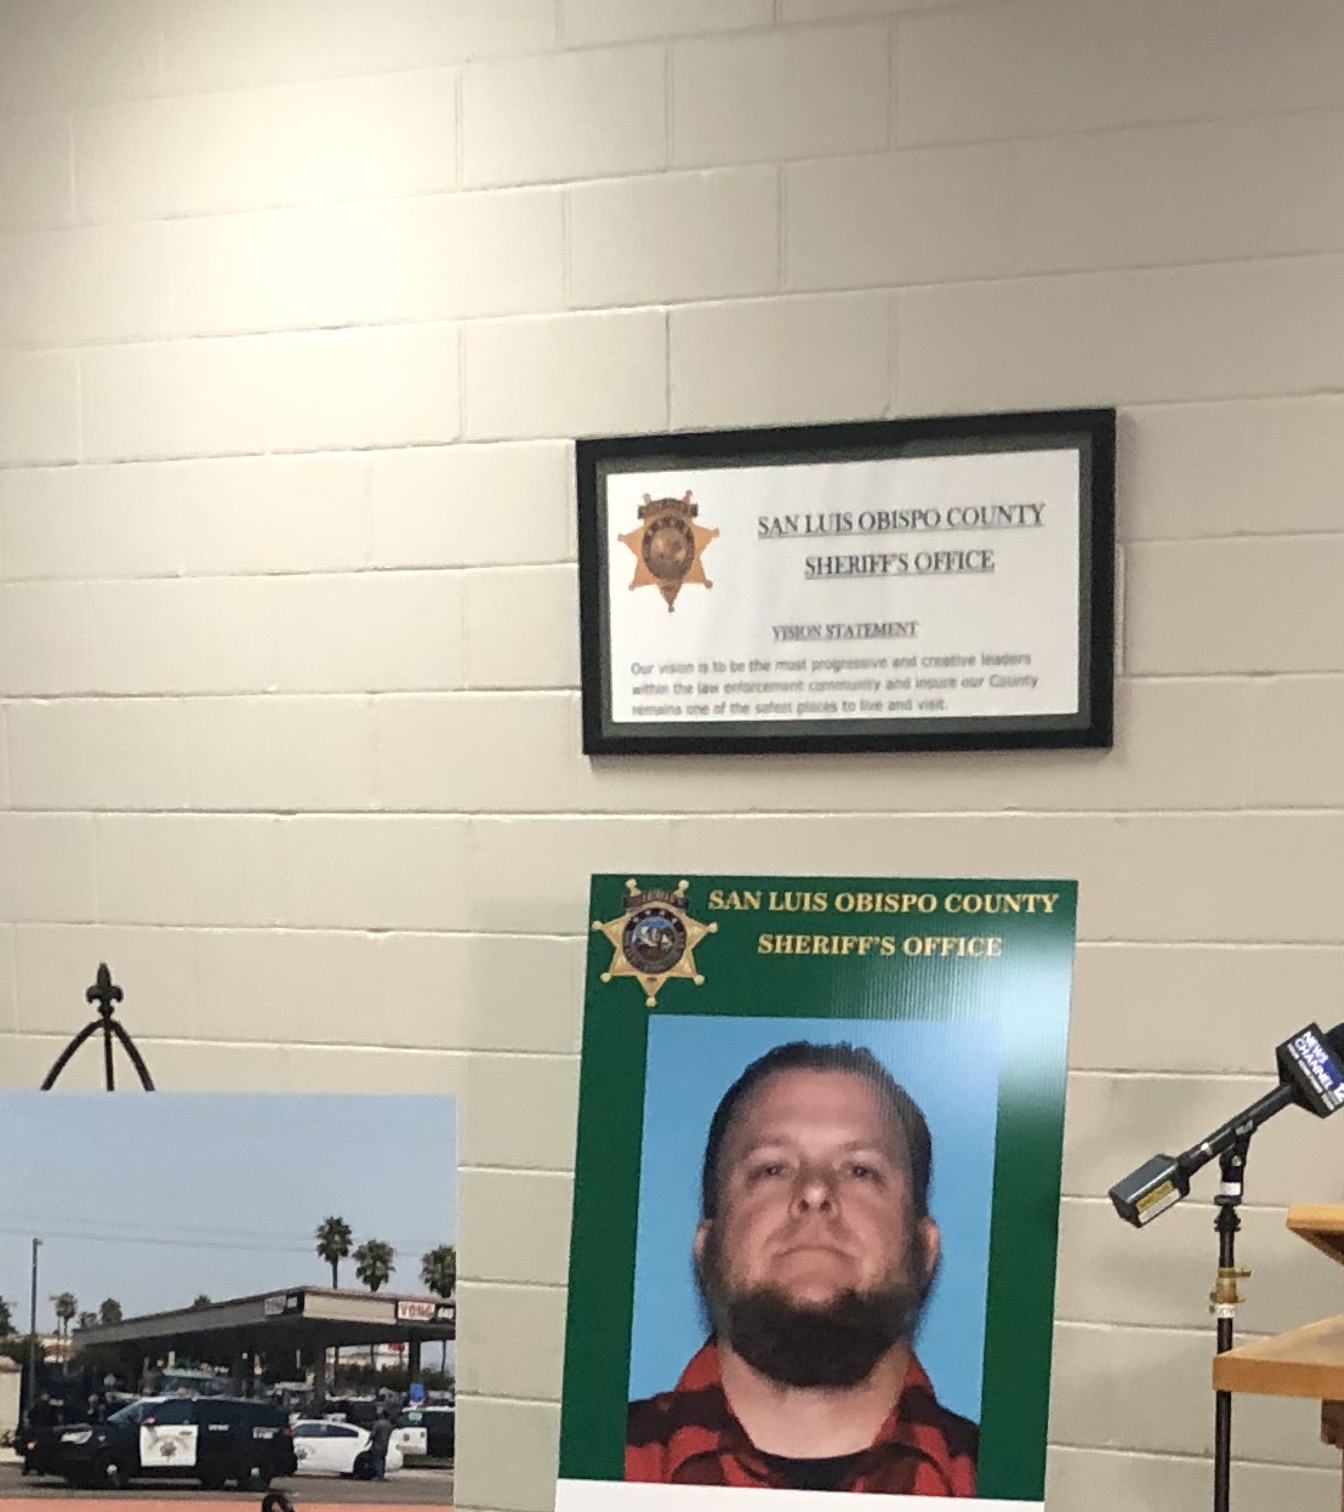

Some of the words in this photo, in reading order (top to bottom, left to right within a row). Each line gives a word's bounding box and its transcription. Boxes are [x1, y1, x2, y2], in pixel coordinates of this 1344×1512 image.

[758, 514, 800, 538] SAN
[805, 511, 854, 535] LUIS
[858, 508, 942, 534] OBISPO
[946, 503, 1046, 530] COUNTY
[805, 553, 909, 578] SHERIFF'S
[914, 550, 995, 573] OFFICE
[772, 624, 822, 641] VISION
[825, 621, 919, 640] STATEMENT
[631, 661, 654, 675] Our
[659, 661, 695, 674] vision
[988, 673, 1039, 690] County
[707, 888, 761, 912] SAN
[768, 890, 829, 913] LUIS
[834, 891, 938, 914] OBISPO
[943, 892, 1060, 915] COUNTY
[757, 932, 896, 957] SHERIFF'S
[901, 935, 1003, 958] OFFICE
